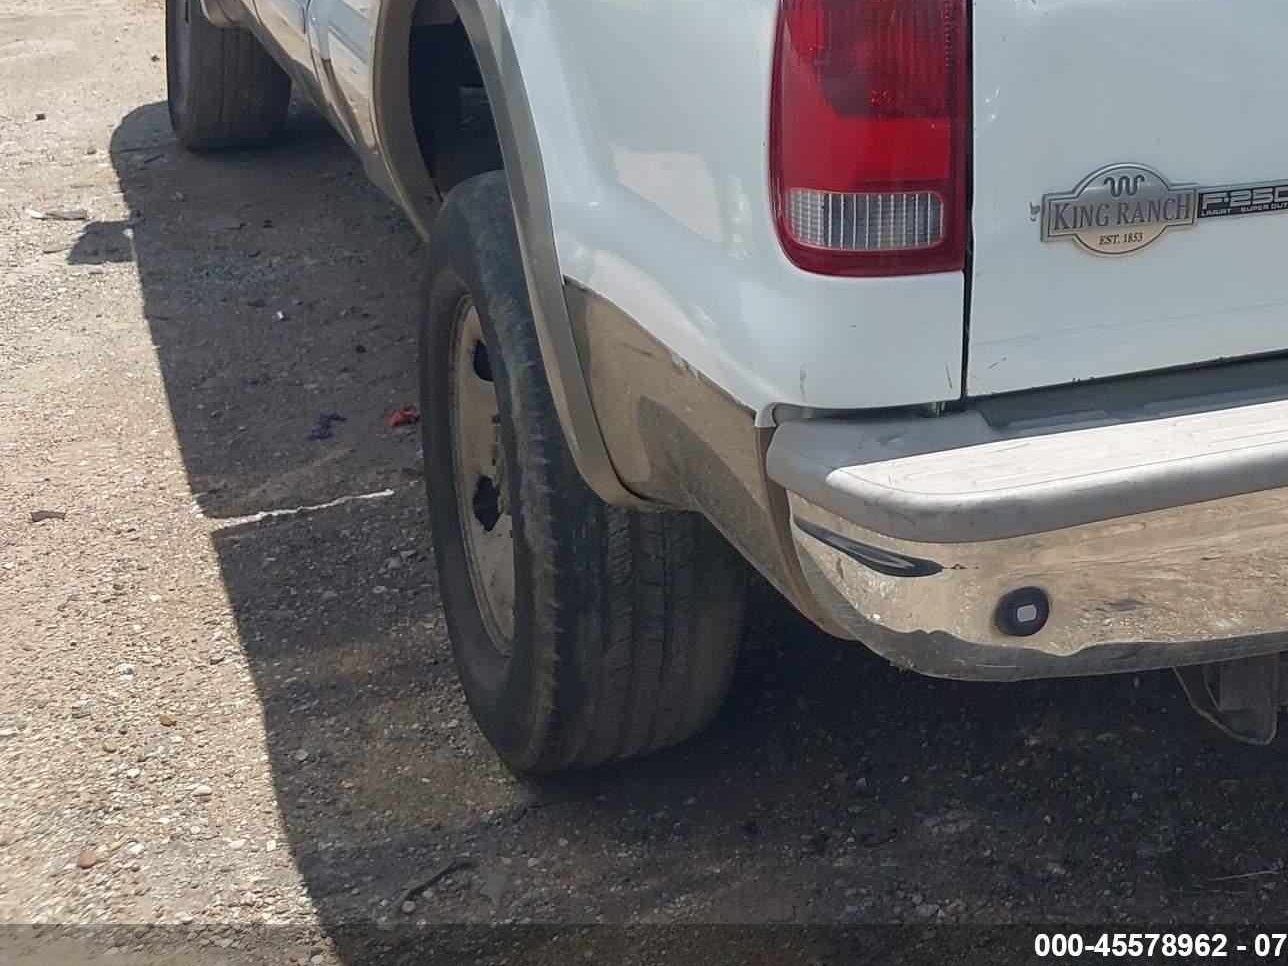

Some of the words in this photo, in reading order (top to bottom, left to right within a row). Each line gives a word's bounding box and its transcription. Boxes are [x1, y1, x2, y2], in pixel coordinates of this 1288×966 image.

[1053, 203, 1110, 231] KING
[1117, 193, 1191, 225] RANCH
[1240, 204, 1269, 213] SUPER
[1099, 234, 1121, 245] EST.
[1123, 232, 1144, 243] 1853
